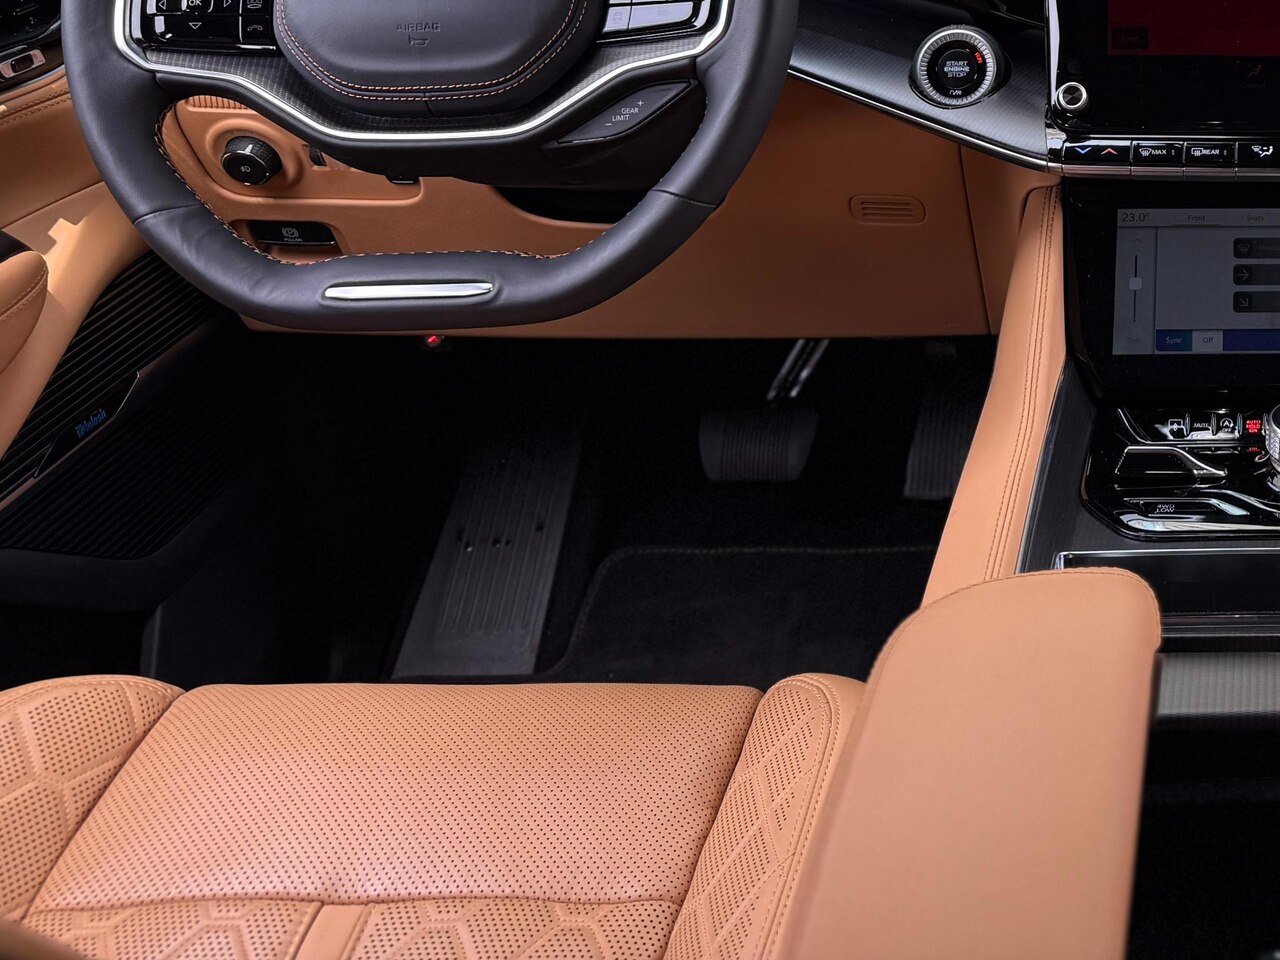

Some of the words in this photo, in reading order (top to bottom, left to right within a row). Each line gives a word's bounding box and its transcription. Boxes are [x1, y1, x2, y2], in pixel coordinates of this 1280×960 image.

[396, 22, 441, 33] AIRBAG
[1188, 214, 1206, 222] Front
[1165, 336, 1182, 345] Sync
